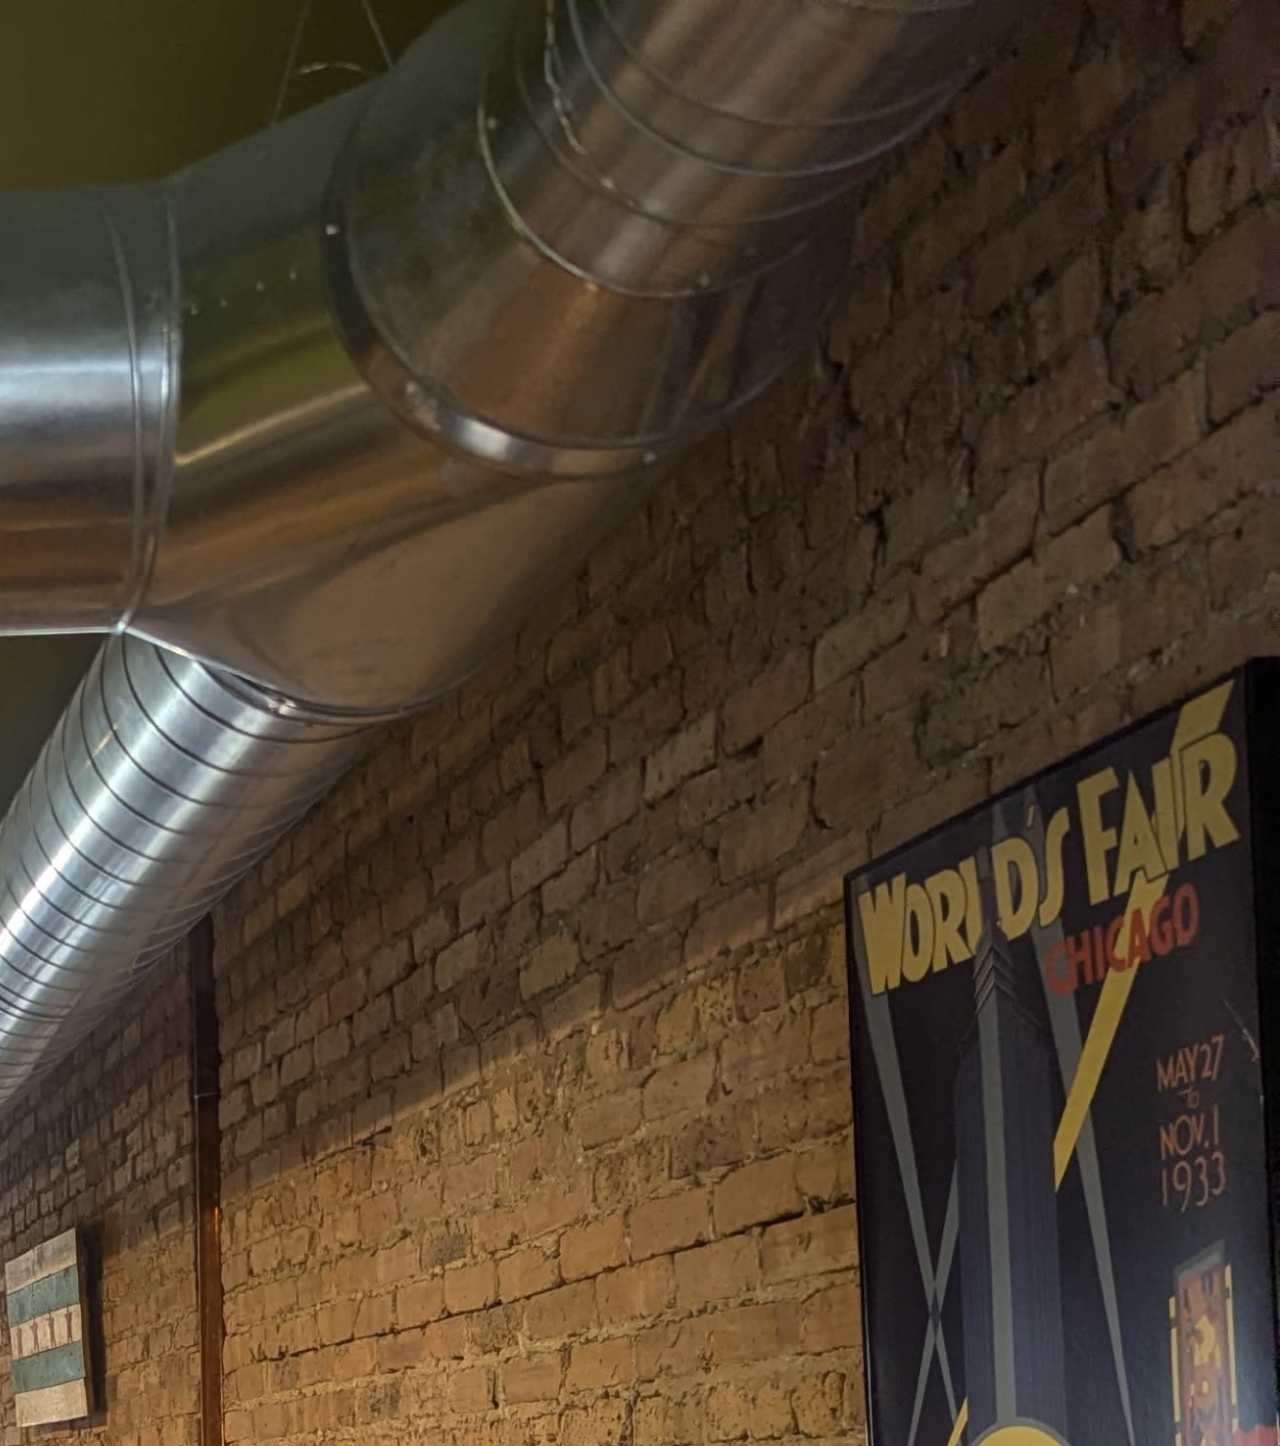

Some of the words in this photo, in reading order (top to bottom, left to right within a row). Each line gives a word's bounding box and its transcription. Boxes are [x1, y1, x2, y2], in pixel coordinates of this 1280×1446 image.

[1077, 731, 1241, 906] FAIR
[1045, 882, 1200, 994] CHICAGO
[1156, 1043, 1200, 1092] MAY
[1200, 1033, 1224, 1080] 27
[1160, 1113, 1210, 1160] NOV.
[1162, 1151, 1227, 1213] 1933
